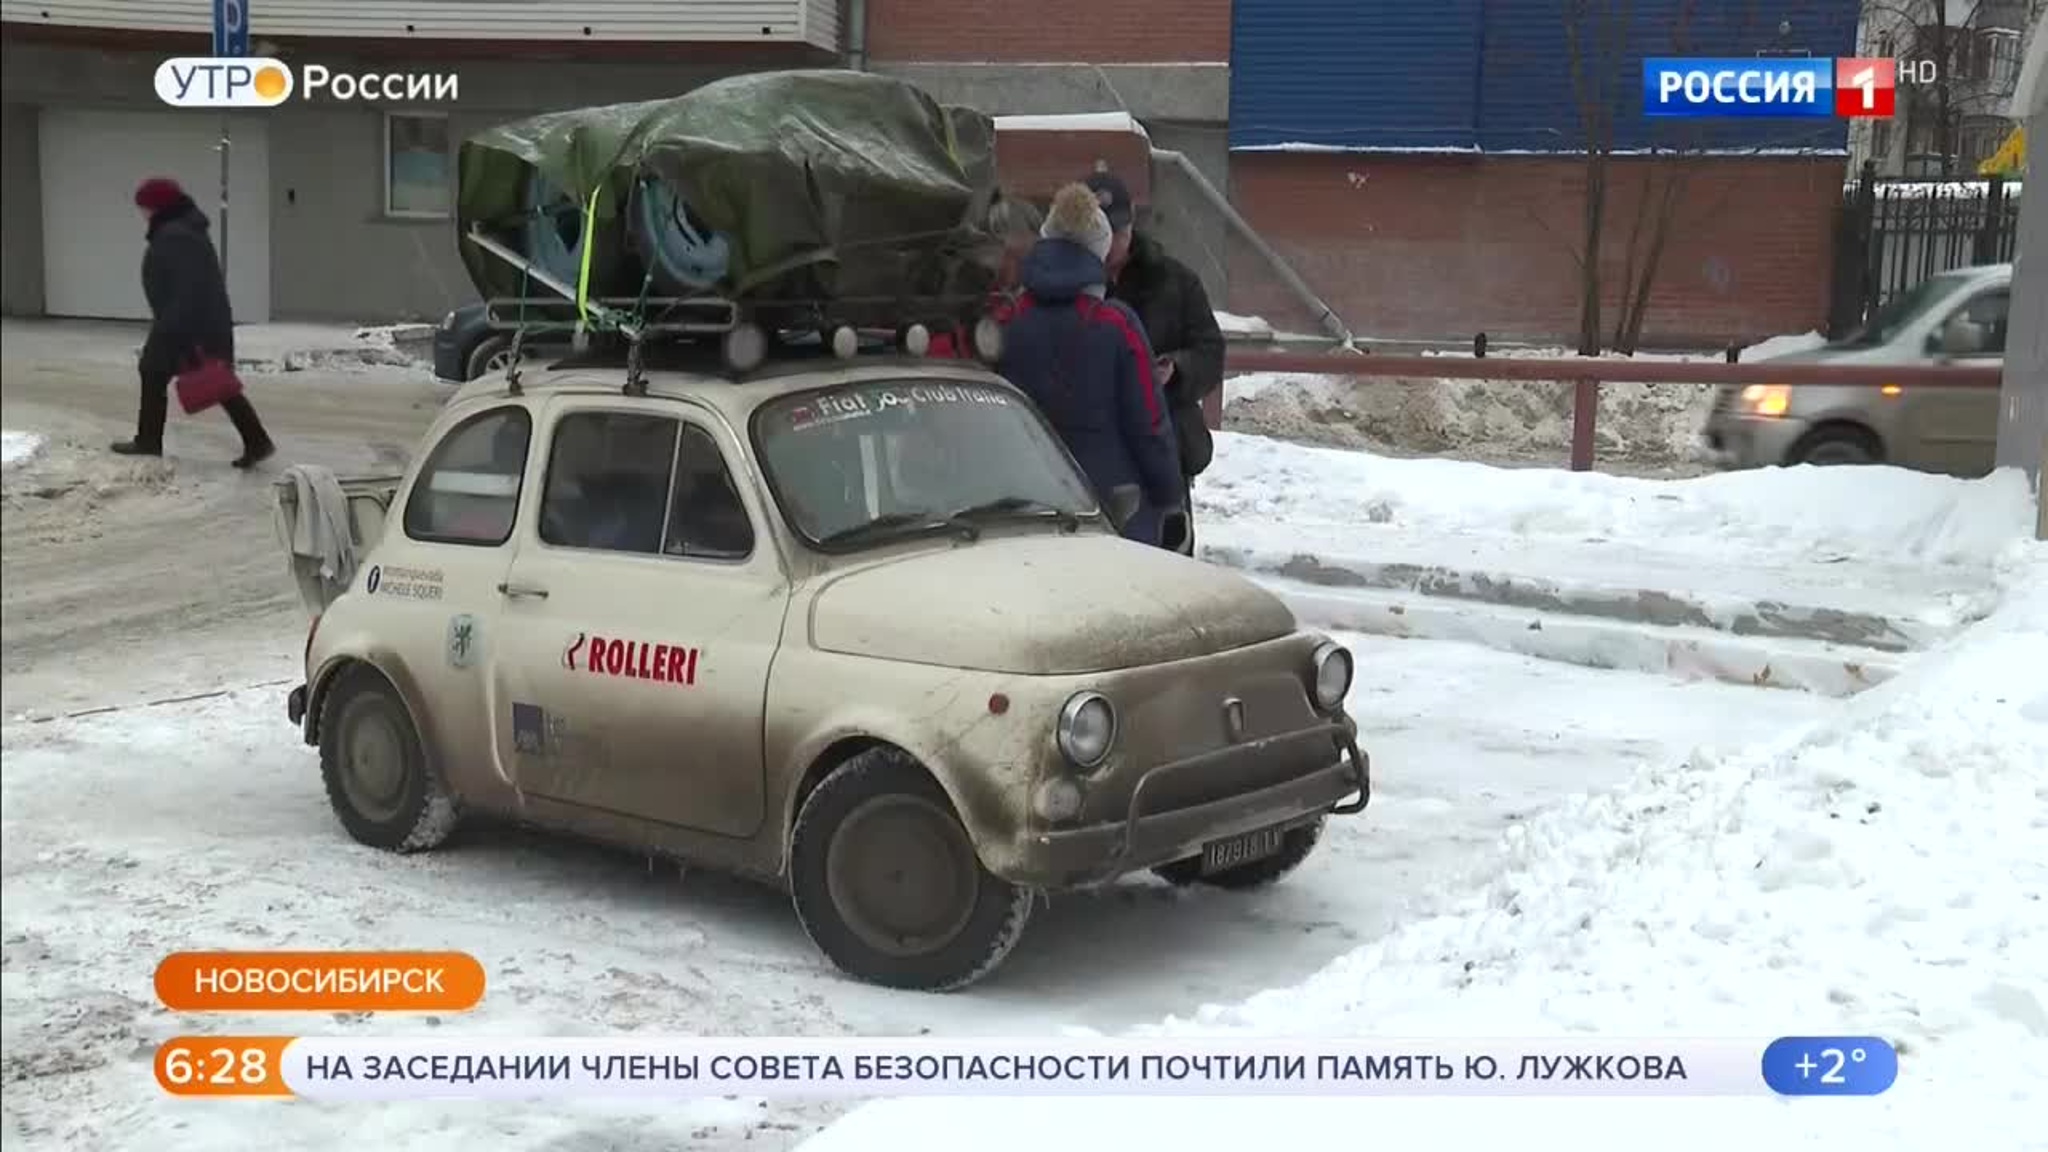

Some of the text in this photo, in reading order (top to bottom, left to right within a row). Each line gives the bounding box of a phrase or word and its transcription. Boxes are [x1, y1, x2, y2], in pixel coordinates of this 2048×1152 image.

[817, 393, 867, 416] Fiat
[911, 385, 957, 402] Club
[588, 636, 698, 686] ROLLERI
